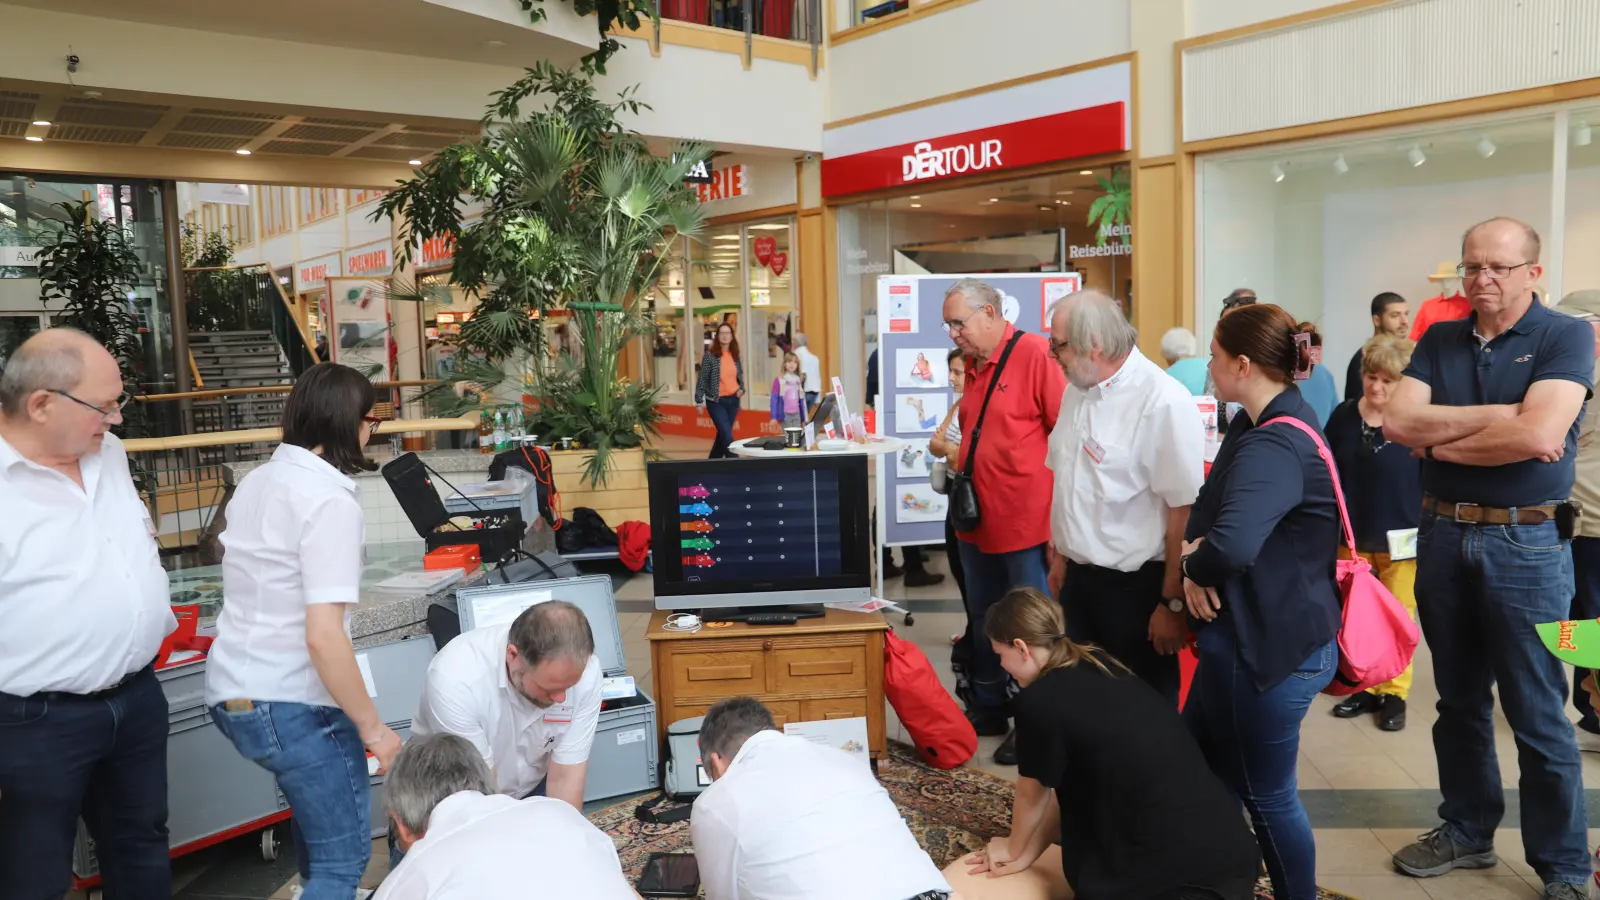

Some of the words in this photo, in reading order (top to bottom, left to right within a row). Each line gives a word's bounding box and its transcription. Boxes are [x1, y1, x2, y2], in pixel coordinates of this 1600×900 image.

[902, 139, 1002, 181] DERTOUR
[1101, 223, 1132, 236] Mein
[348, 248, 387, 274] SPIELWAREN
[1069, 242, 1132, 259] Reisebüro
